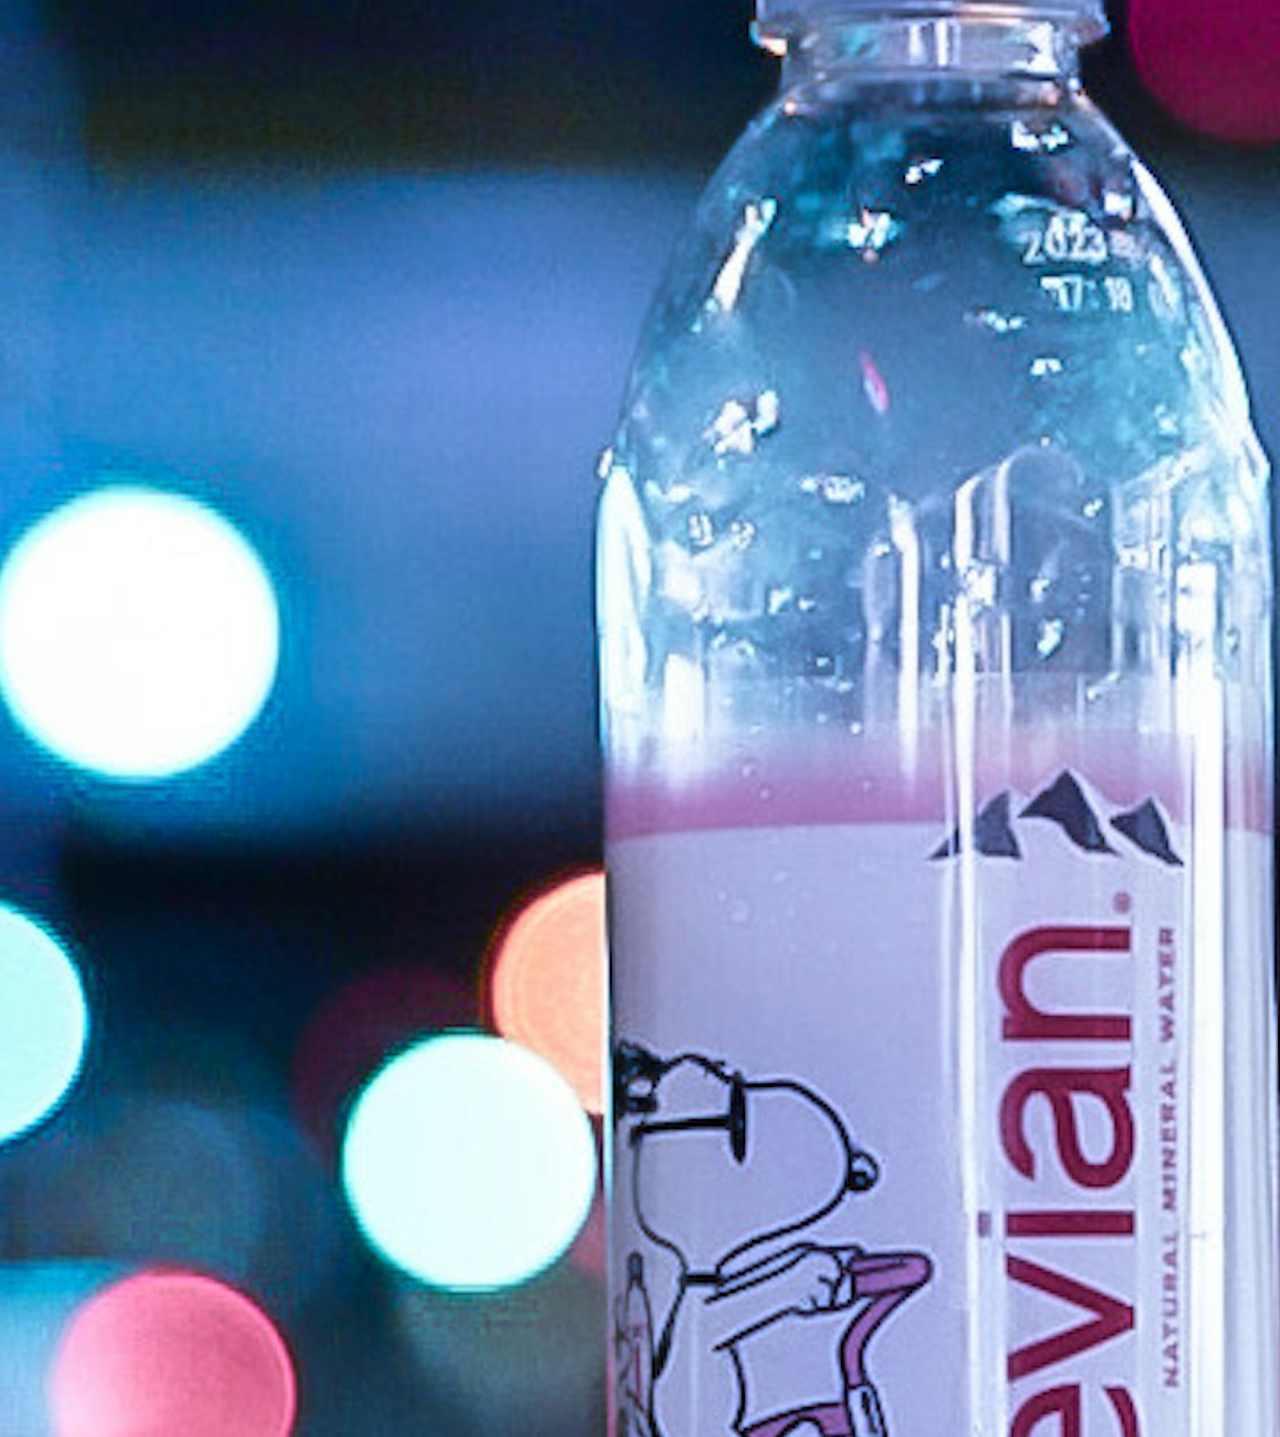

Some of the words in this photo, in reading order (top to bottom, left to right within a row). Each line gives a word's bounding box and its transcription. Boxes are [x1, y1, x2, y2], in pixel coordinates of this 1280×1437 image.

[1158, 926, 1175, 1043] WATER
[1160, 1059, 1178, 1210] MINERAL
[1161, 1231, 1180, 1388] NATURAL
